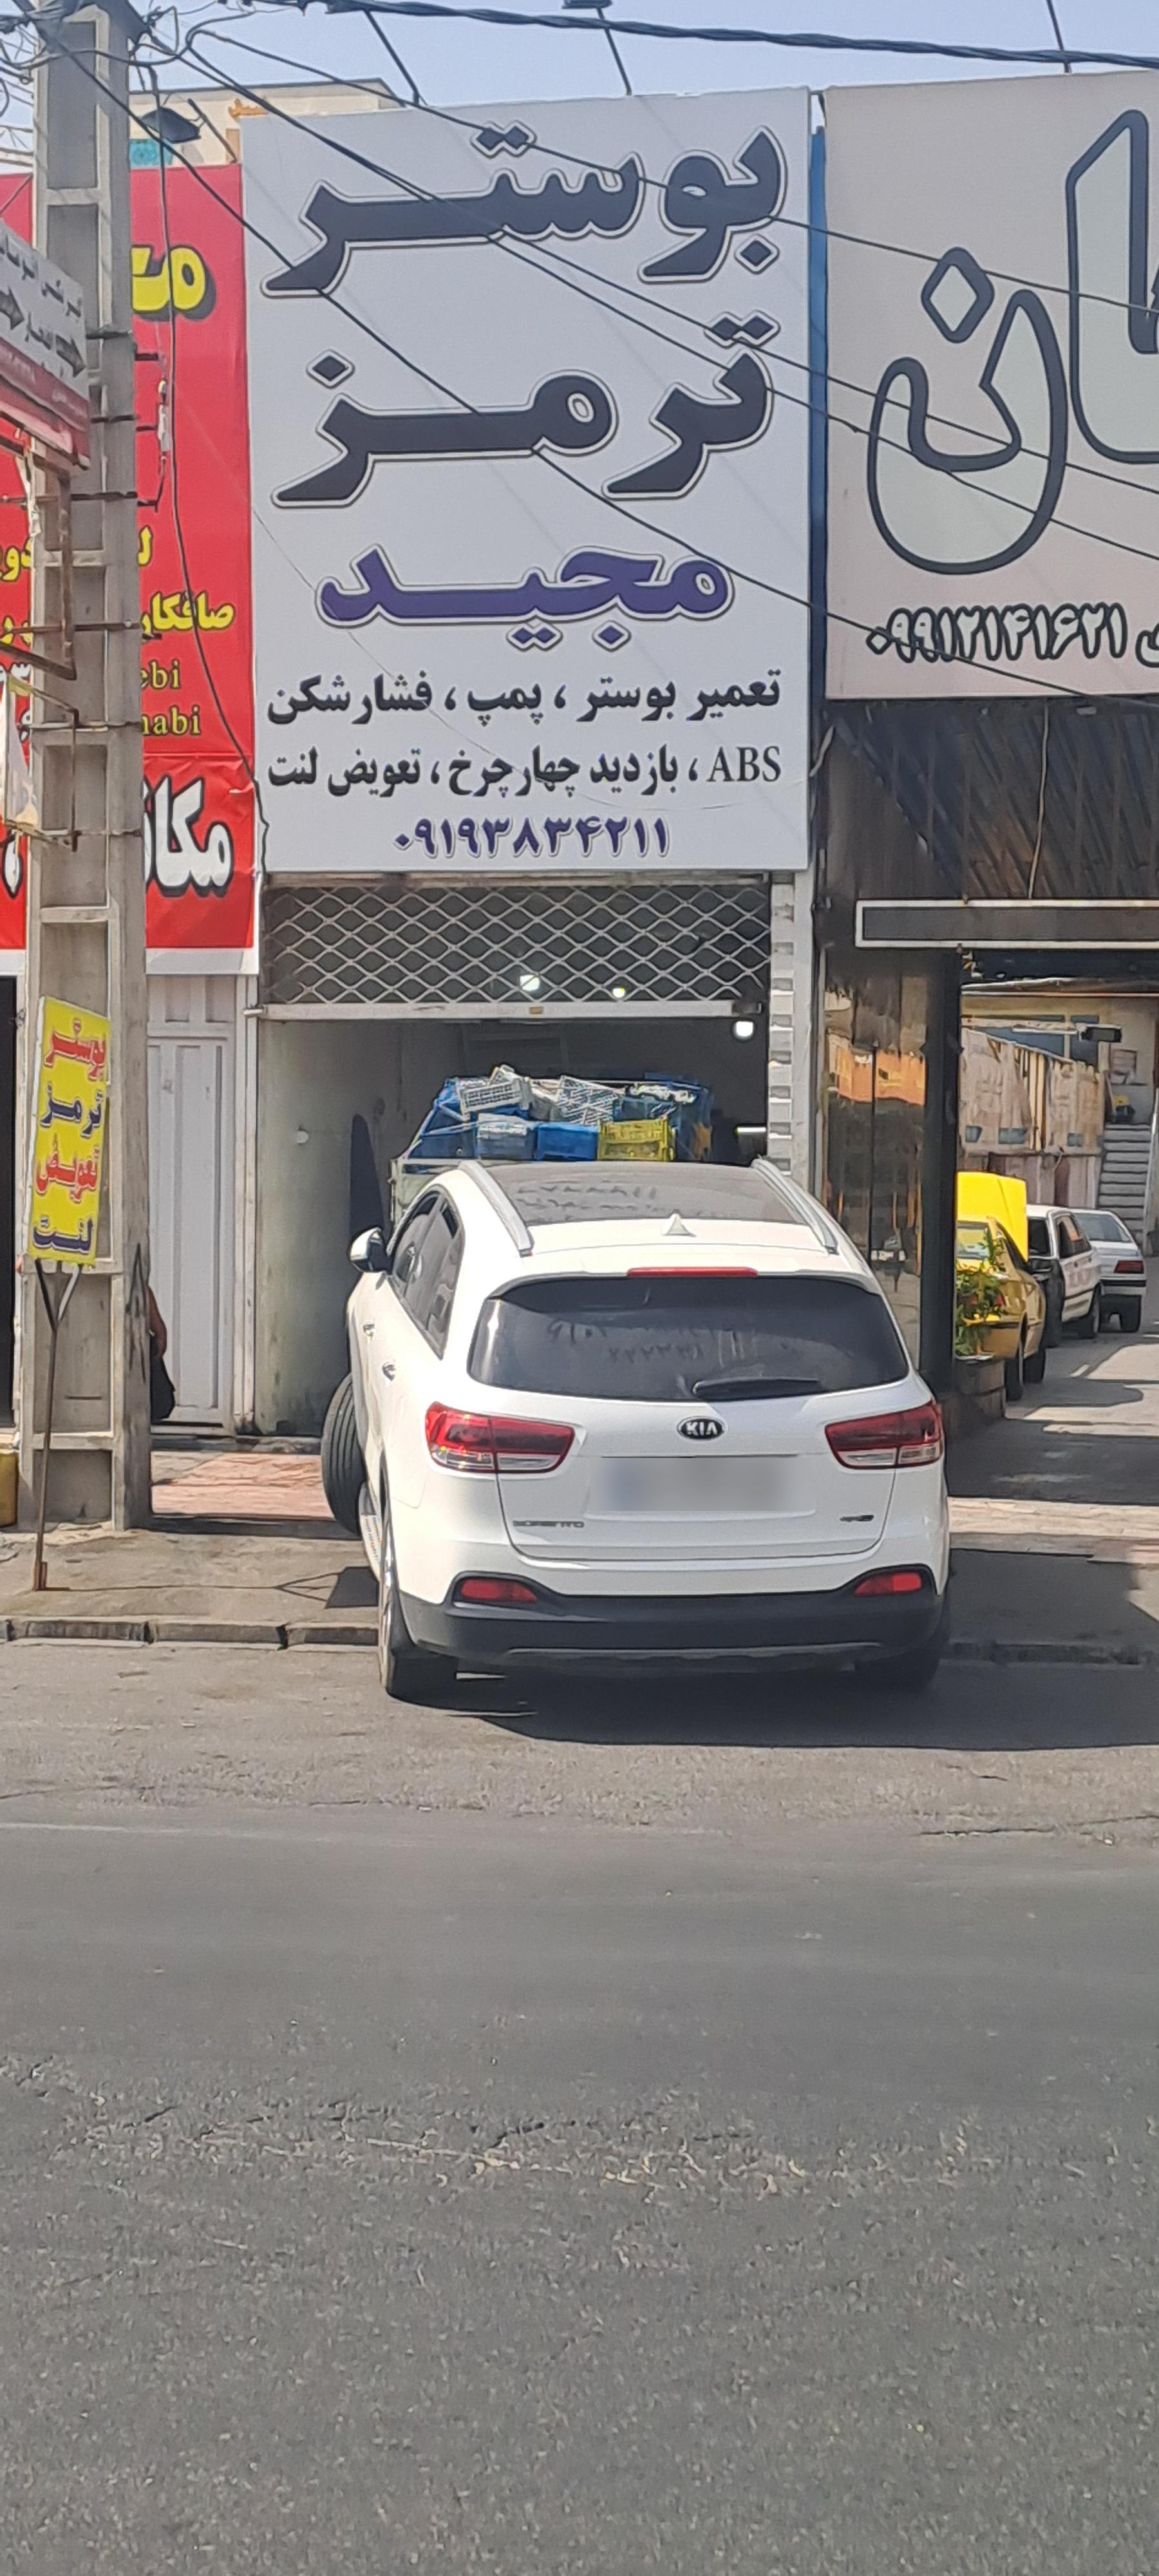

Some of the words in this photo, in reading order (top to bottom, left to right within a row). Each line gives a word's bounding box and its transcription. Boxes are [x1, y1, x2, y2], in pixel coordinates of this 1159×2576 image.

[261, 120, 786, 297] بوستر
[270, 312, 780, 508] ترمز
[316, 544, 734, 651] مجید
[467, 683, 543, 726] پمپ
[576, 676, 676, 722] بوستر
[686, 668, 781, 721] تعمیر
[269, 746, 317, 786] لنت
[328, 748, 420, 797] تعویض
[590, 744, 678, 796] بازدید
[706, 745, 781, 782] ABS
[393, 815, 669, 858] ۰۹۱۹۳۸۳۴۲۱۱
[44, 1018, 106, 1081] بوستر
[39, 1081, 103, 1138] ترمز
[36, 1133, 100, 1202] تعویض
[33, 1215, 93, 1255] لنت
[686, 1421, 718, 1436] KIA
